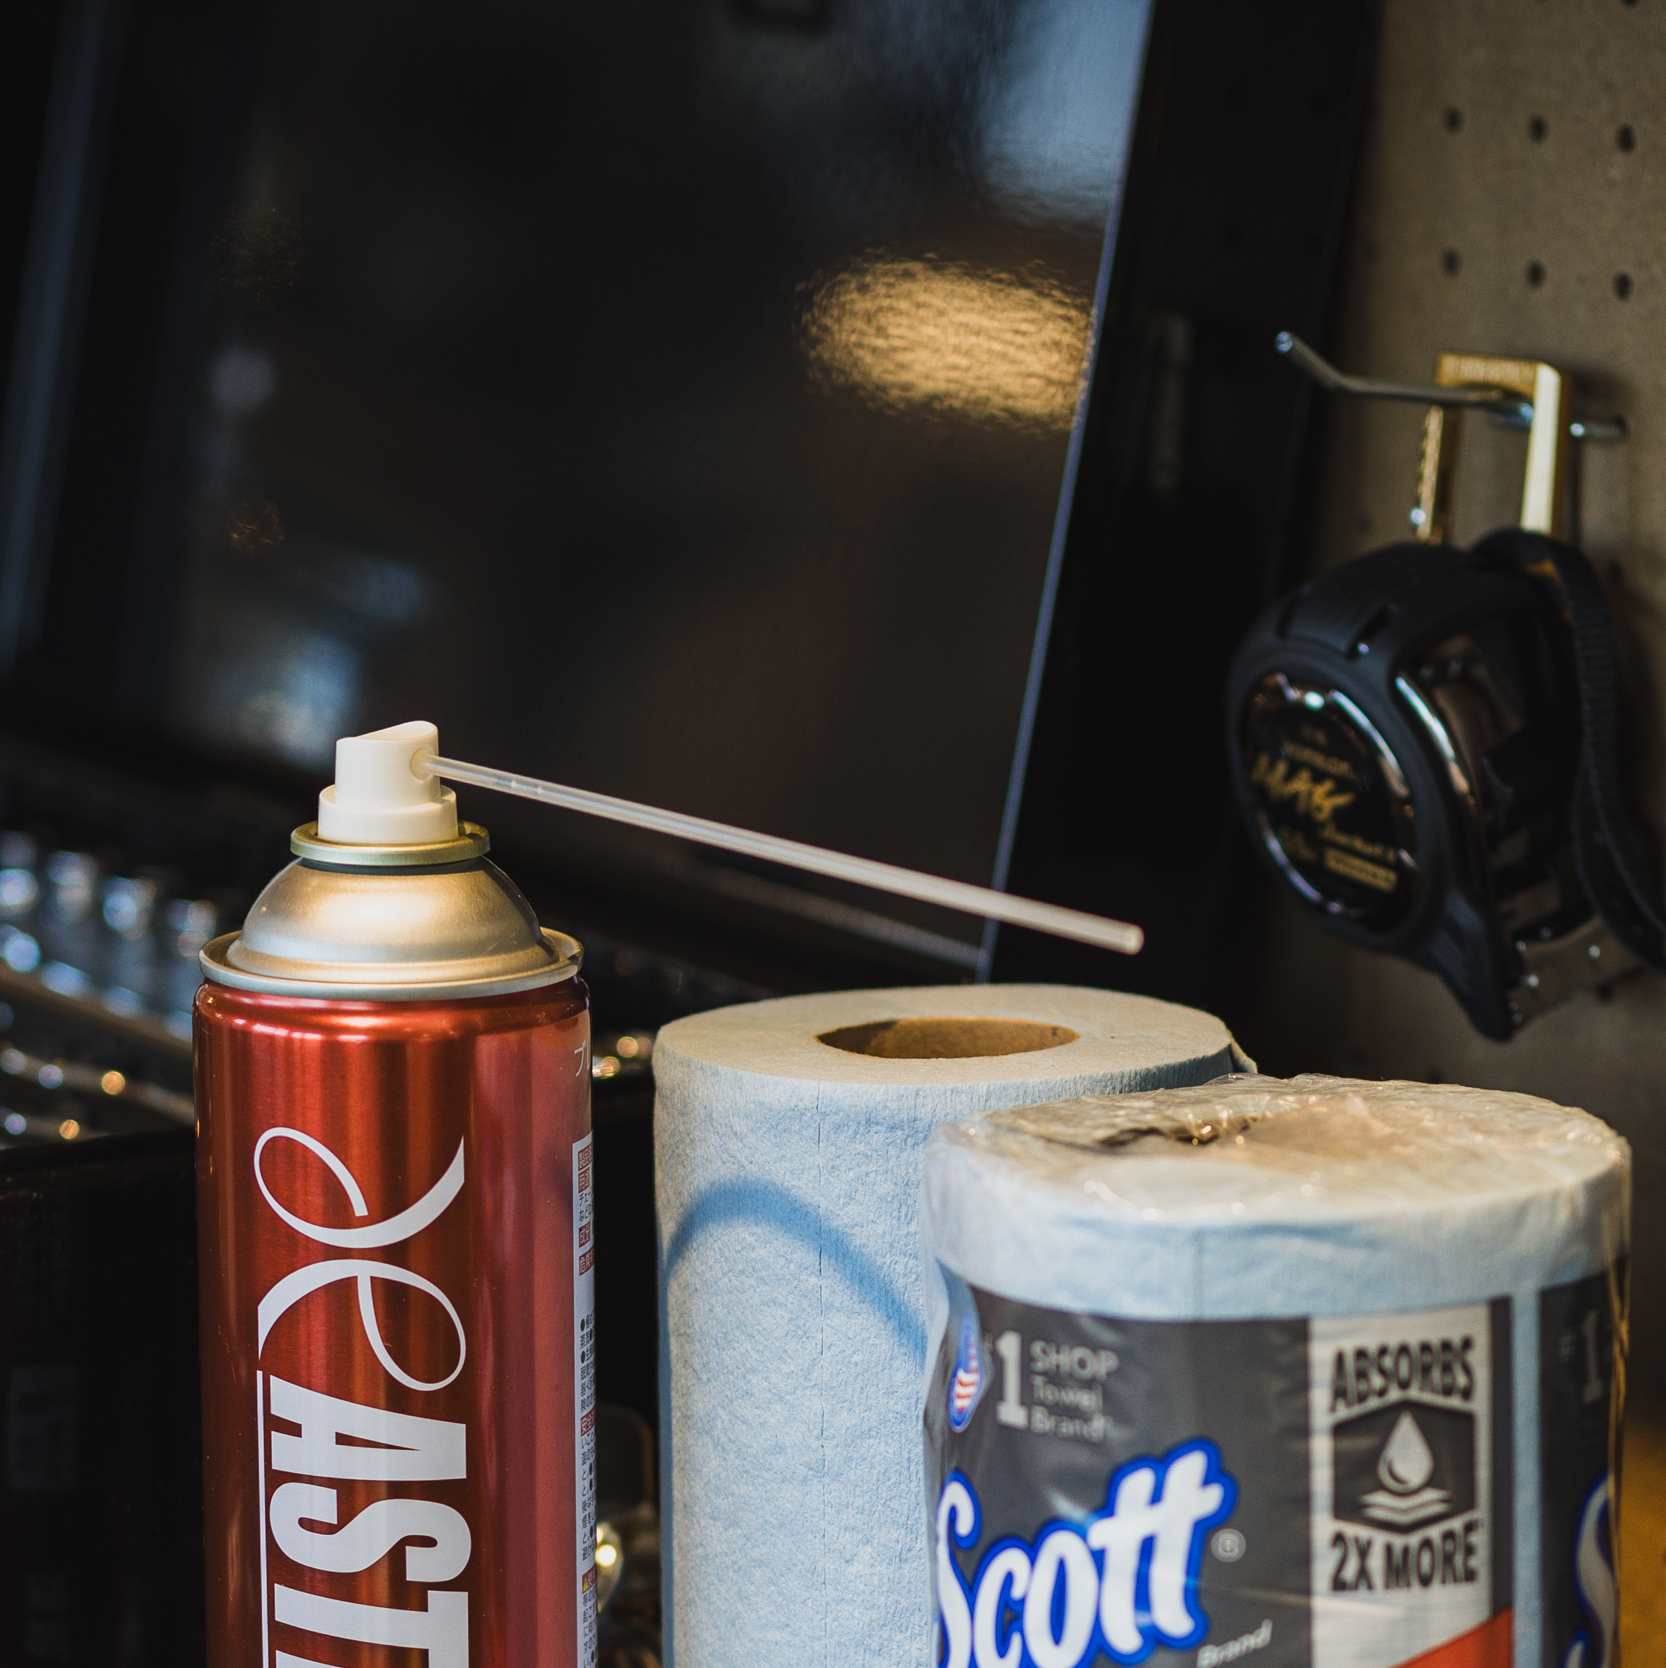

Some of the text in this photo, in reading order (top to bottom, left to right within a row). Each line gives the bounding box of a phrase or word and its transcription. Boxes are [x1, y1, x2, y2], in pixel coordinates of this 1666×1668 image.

[1030, 1339, 1120, 1384] SHOP
[1329, 1335, 1475, 1415] ABSORBS
[1331, 1518, 1479, 1592] 2X MORE
